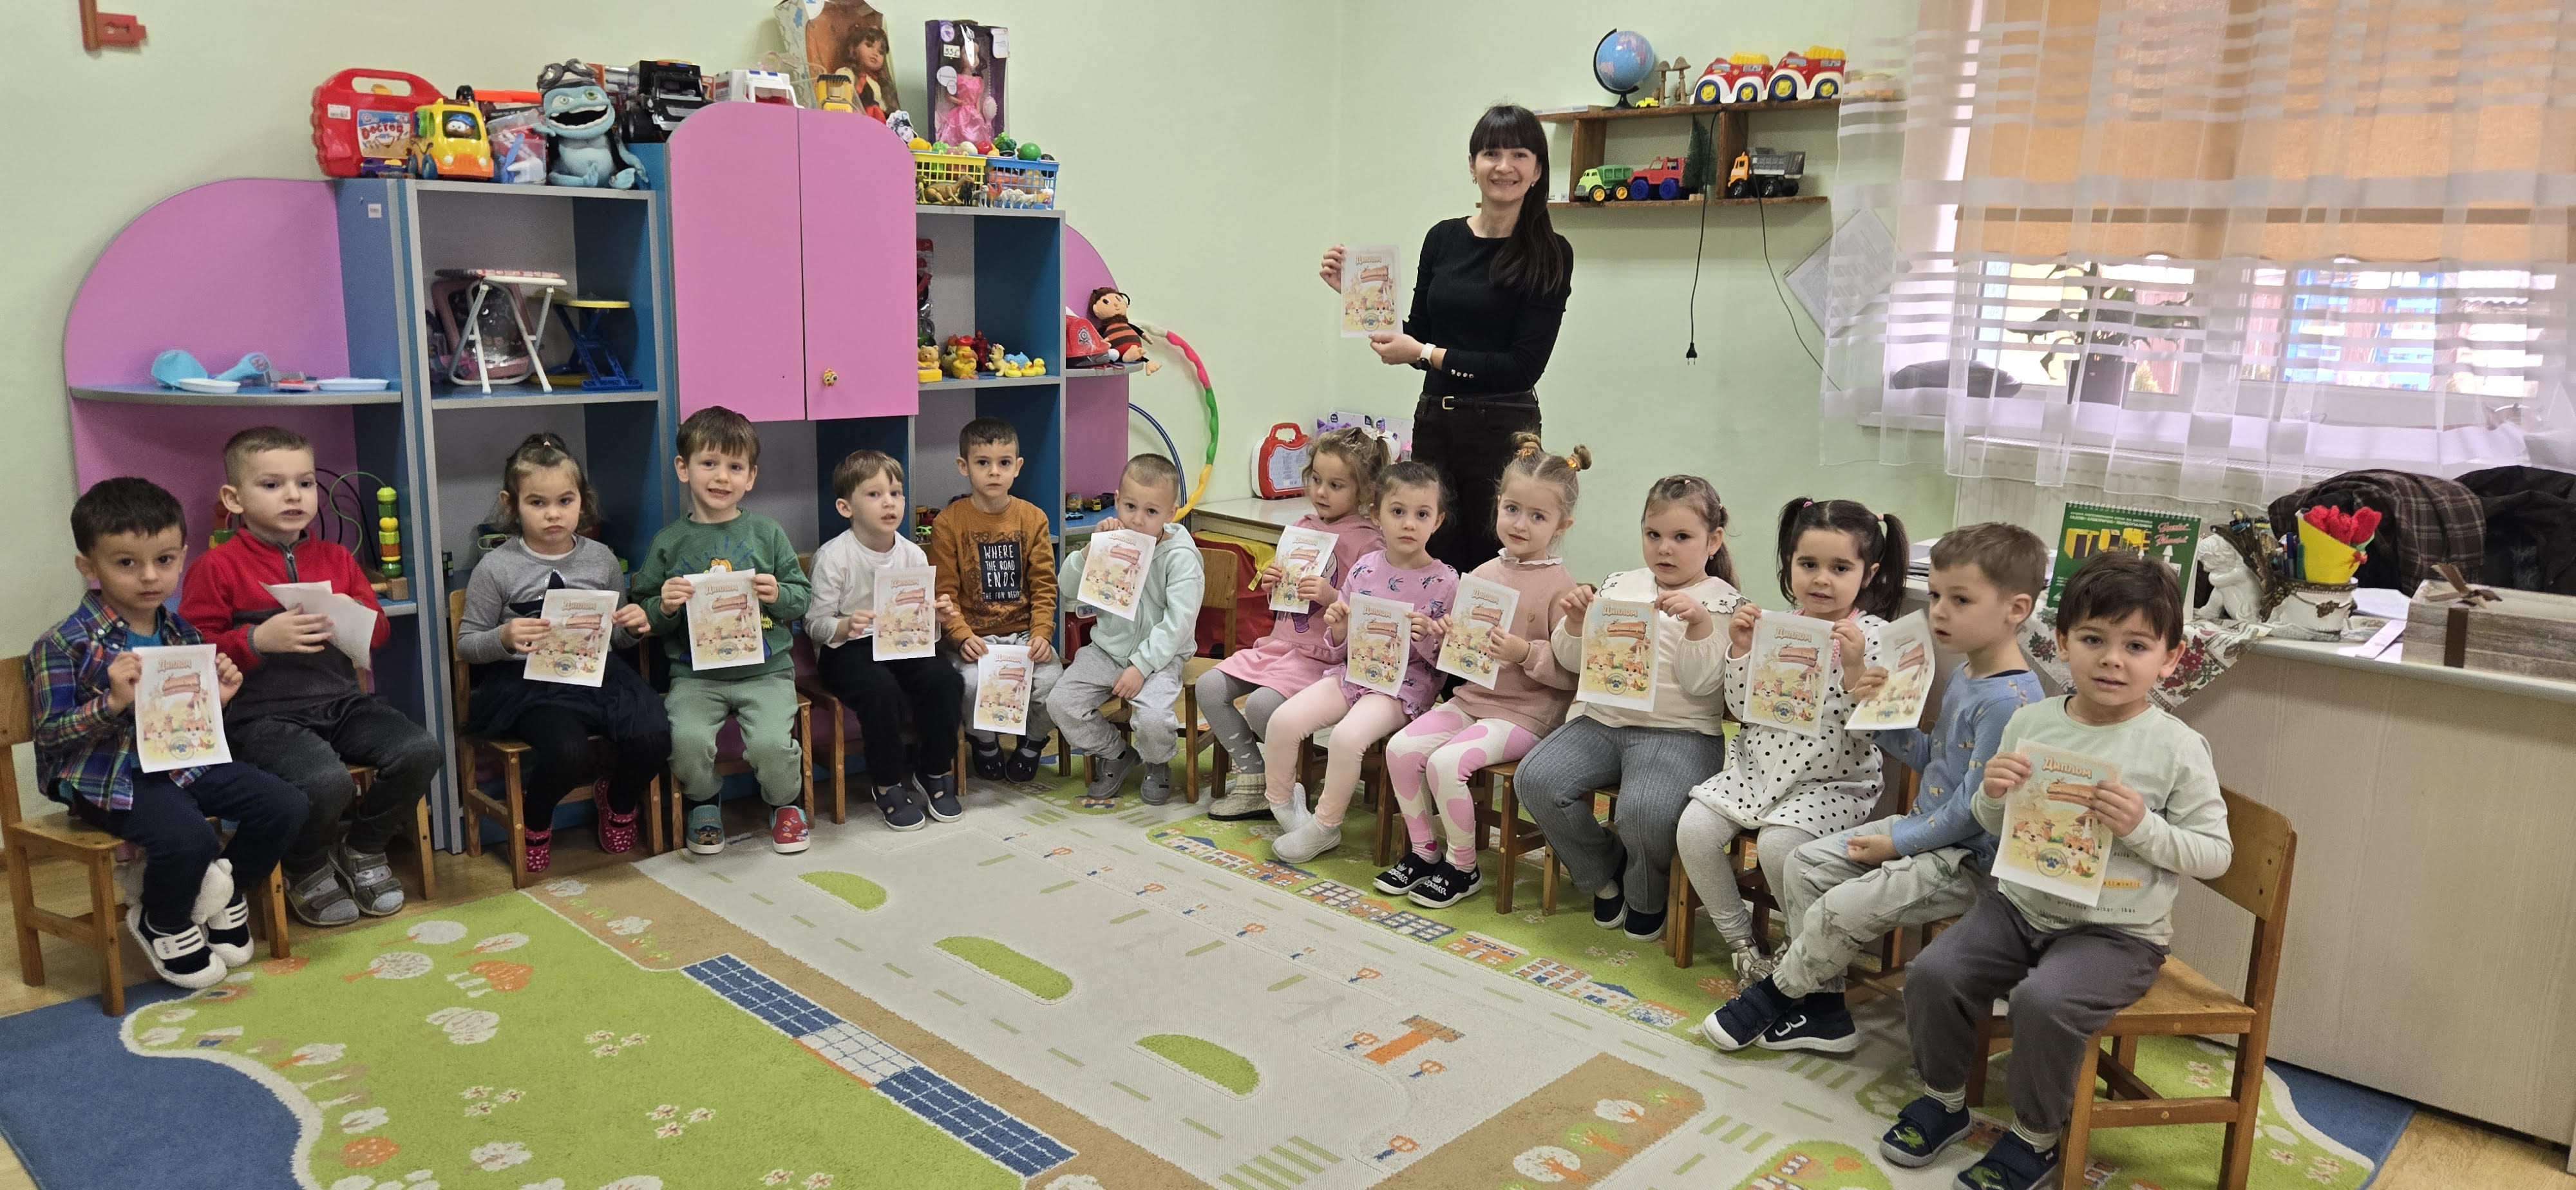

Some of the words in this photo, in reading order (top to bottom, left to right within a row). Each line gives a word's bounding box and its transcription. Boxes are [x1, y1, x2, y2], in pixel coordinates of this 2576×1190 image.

[1109, 533, 1137, 546] Диплом
[983, 544, 1014, 560] WHERE
[985, 560, 997, 572] THE
[999, 560, 1016, 571] ROAD
[987, 571, 1016, 588] ENDS
[705, 585, 739, 596] Диплом
[1472, 589, 1499, 605] Диплом
[562, 600, 596, 611] Диплом
[1363, 604, 1392, 619] Диплом
[1602, 605, 1638, 618] Диплом
[1775, 627, 1812, 642] Диплом
[157, 659, 192, 673] Диплом
[2041, 756, 2092, 779] Диплом
